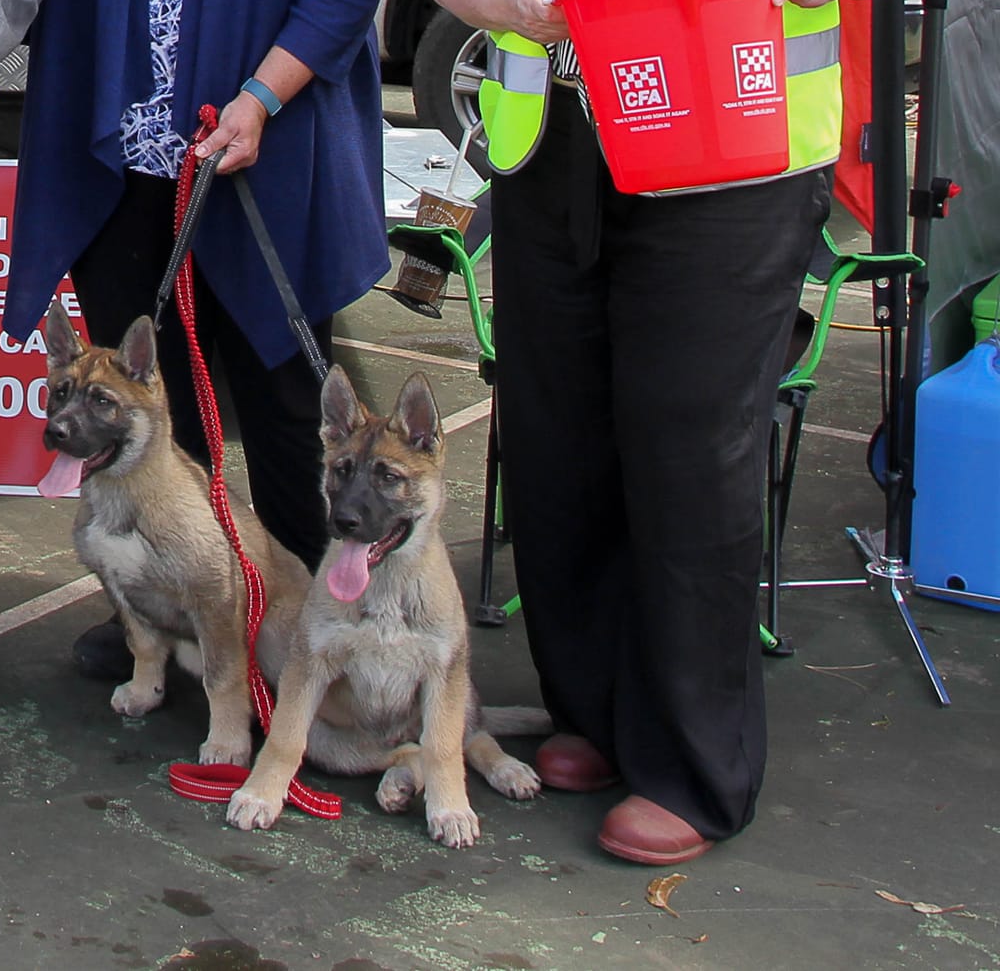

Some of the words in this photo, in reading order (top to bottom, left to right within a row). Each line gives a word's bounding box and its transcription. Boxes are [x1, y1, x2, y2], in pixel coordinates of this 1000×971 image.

[743, 72, 773, 91] CFA
[624, 88, 662, 107] CFA
[0, 330, 48, 354] CA
